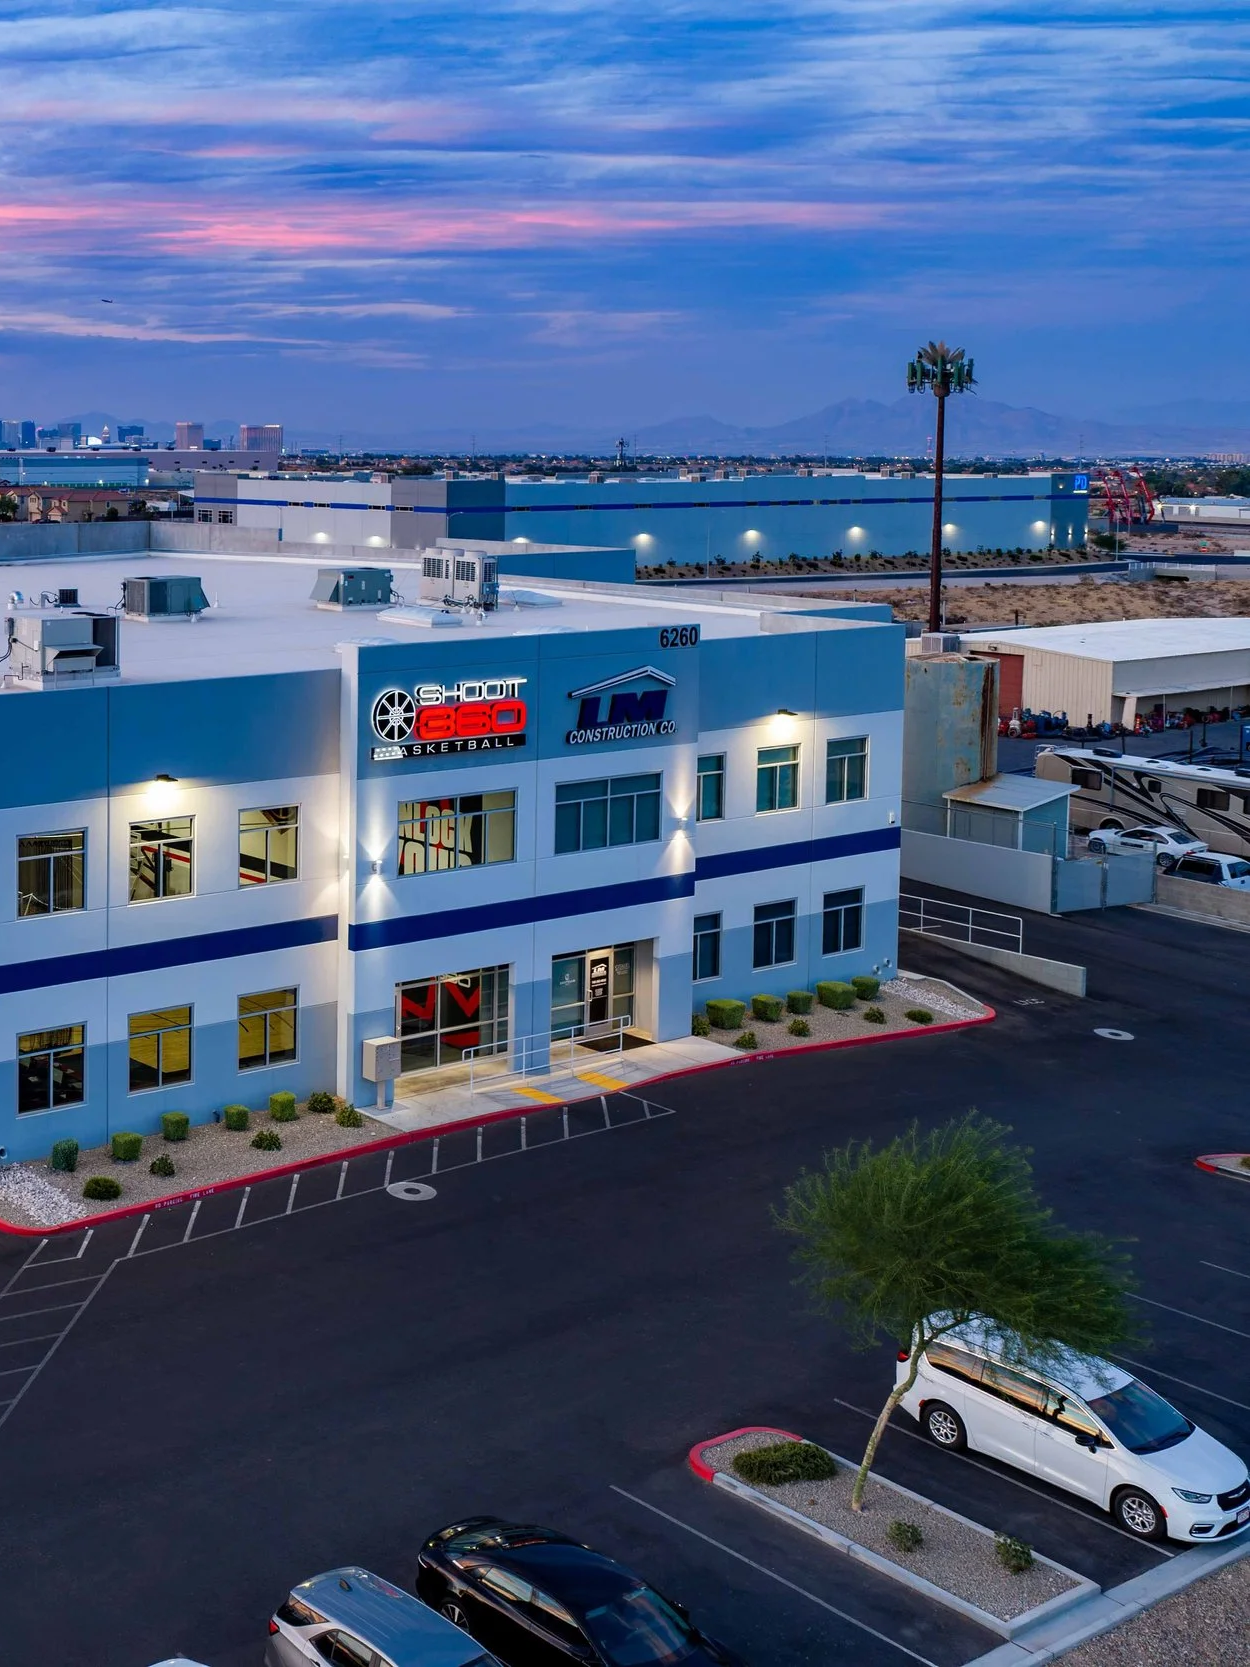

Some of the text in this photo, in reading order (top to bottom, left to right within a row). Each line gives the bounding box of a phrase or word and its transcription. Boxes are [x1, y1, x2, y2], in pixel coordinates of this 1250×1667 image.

[660, 626, 698, 648] 6260
[417, 678, 527, 706] SHOOT
[416, 699, 527, 740] 360
[577, 690, 668, 729] LM
[568, 721, 657, 745] CONSTRUCTION
[388, 736, 515, 757] ASKETBALL
